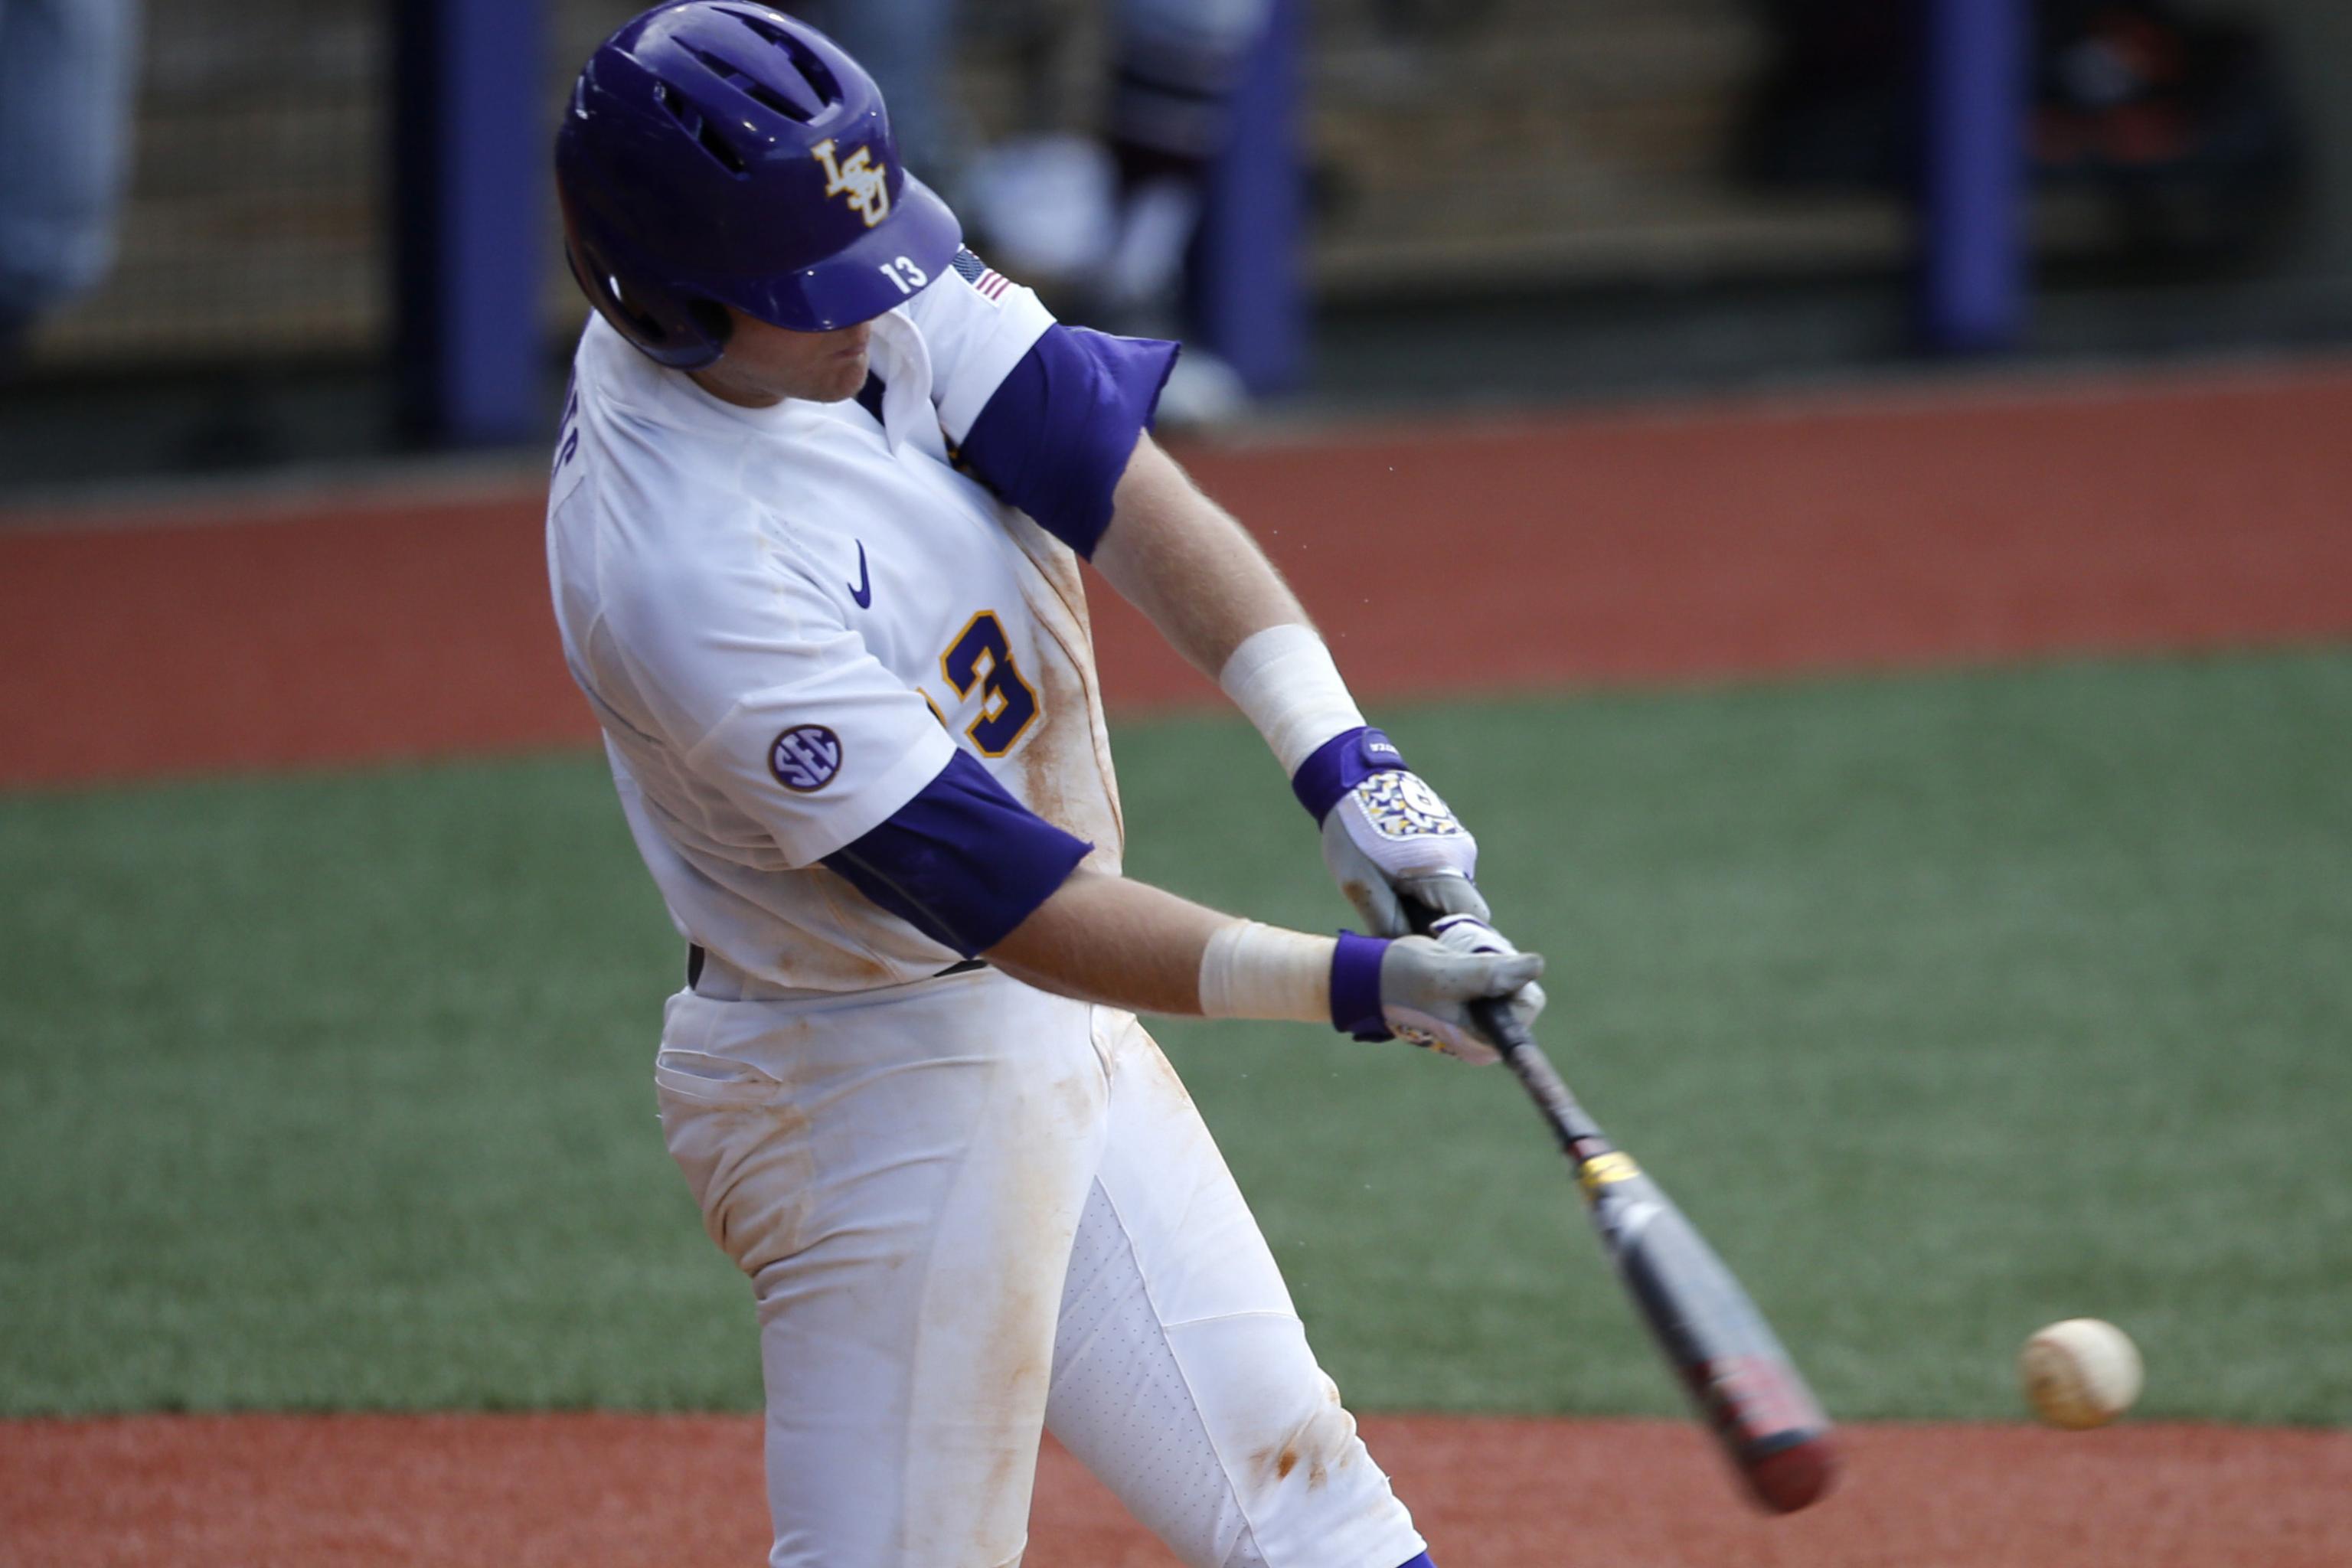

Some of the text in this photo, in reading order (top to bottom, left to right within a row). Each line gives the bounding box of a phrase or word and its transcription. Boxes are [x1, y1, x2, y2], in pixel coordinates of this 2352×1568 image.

[810, 139, 890, 228] LSU
[880, 256, 928, 294] 13
[916, 609, 1041, 758] 3
[774, 729, 838, 787] SEC
